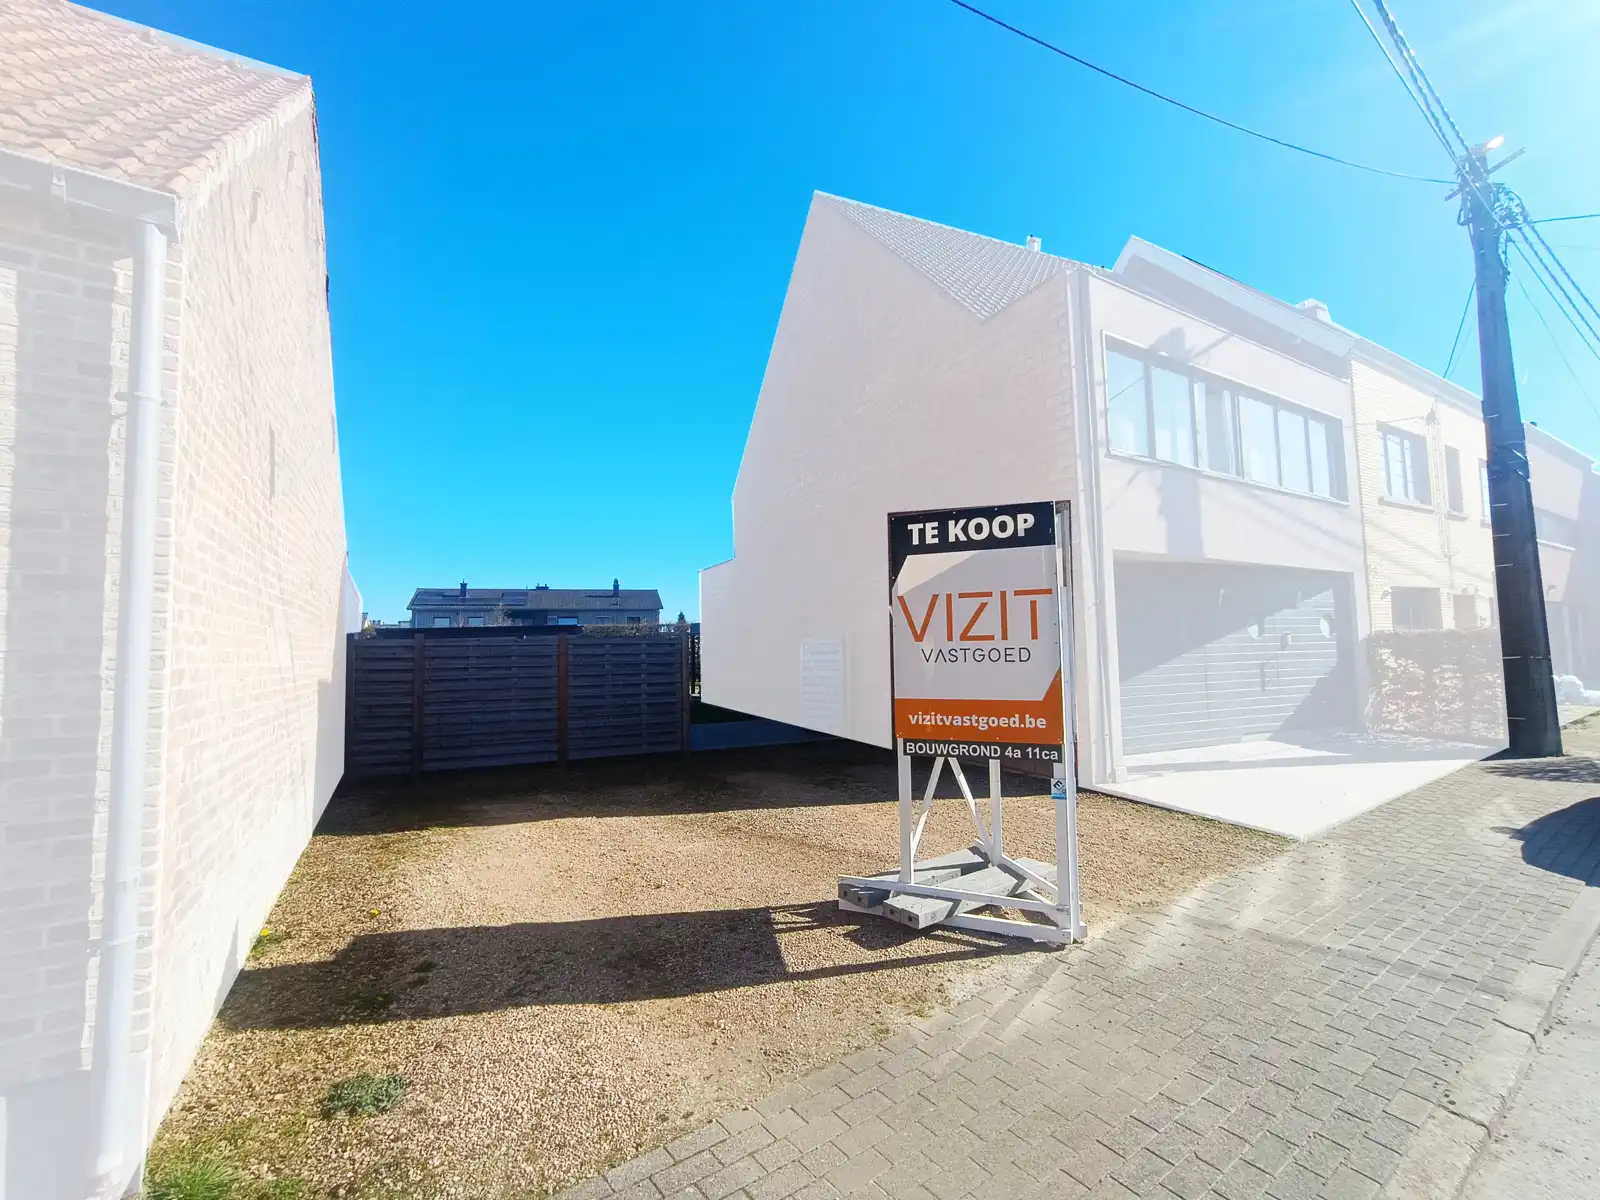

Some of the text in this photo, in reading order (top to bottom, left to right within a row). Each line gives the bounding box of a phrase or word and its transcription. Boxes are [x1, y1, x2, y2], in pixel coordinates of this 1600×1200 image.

[908, 513, 1035, 545] TE KOOP
[896, 588, 1053, 642] VIZIT
[921, 647, 1031, 663] VASTGOED
[908, 711, 1047, 731] vizitvastgoed.be
[906, 742, 1059, 760] BOUWGROND 4a 11ca
